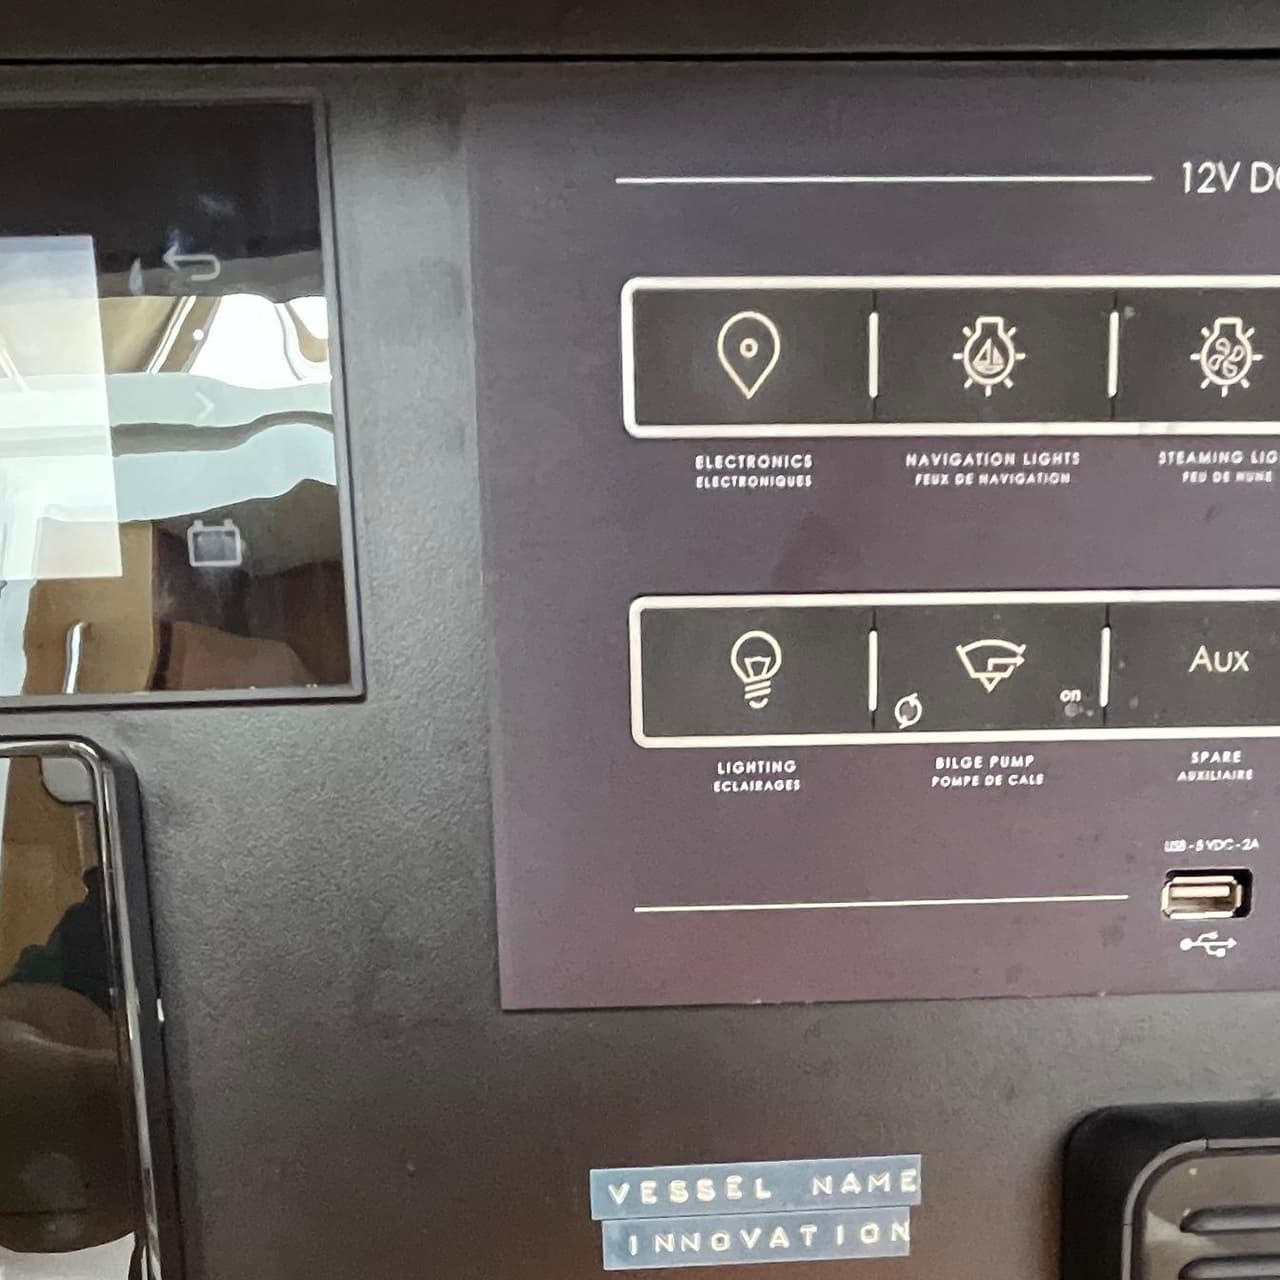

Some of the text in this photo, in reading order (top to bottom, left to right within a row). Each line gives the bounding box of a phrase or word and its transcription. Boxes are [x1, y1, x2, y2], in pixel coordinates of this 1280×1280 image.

[1182, 160, 1241, 194] 12V
[694, 453, 813, 470] ELECTRONICS
[905, 451, 1081, 468] NAVIGATION LIGHTS
[1158, 449, 1244, 466] STEAMING
[695, 474, 813, 489] ELECTRONIQUES
[914, 471, 1072, 486] FEUX DE NAVIGATION
[1182, 470, 1208, 484] FEU
[1212, 470, 1231, 484] DE
[1060, 689, 1082, 703] on
[935, 754, 1035, 770] BILGE PUMP
[1190, 751, 1242, 765] SPARE
[717, 759, 797, 776] LIGHTING
[1176, 768, 1254, 782] AUXILIAIRE
[713, 778, 801, 793] ECLAIRAGES
[931, 773, 1045, 788] POMPE DE CALE
[608, 1168, 918, 1205] VESSEL NAME
[627, 1221, 910, 1256] INNOVATION
